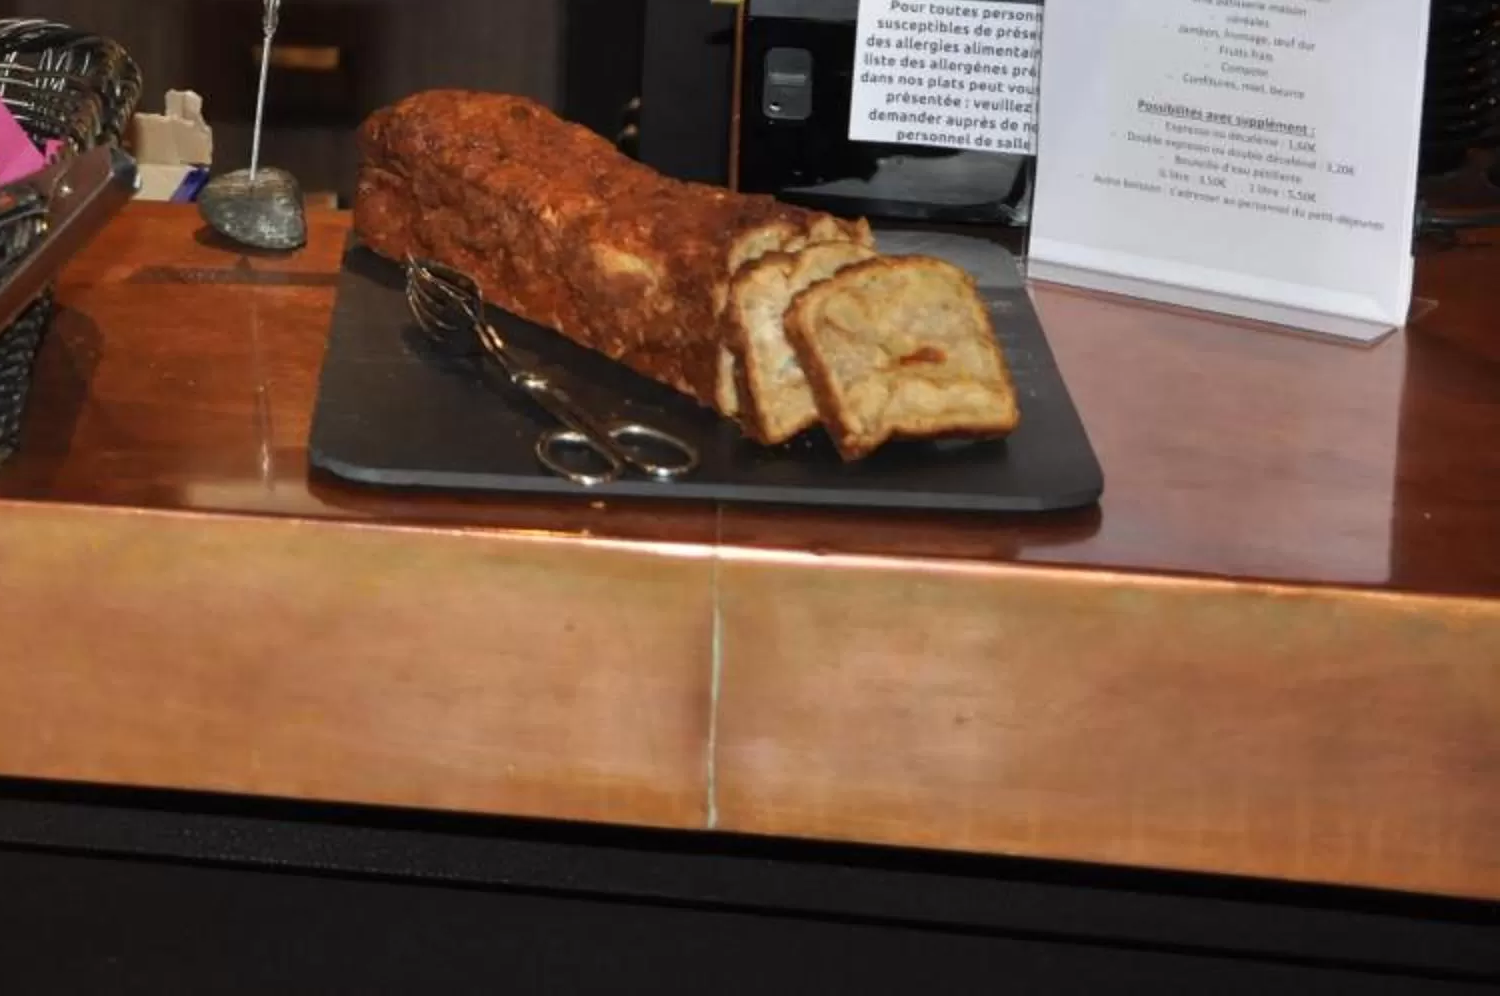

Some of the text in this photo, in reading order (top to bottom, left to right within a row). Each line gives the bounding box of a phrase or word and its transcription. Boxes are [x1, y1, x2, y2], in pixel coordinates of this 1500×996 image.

[891, 0, 926, 13] Pour
[929, 3, 978, 17] toutes
[877, 18, 969, 36] susceptibles
[973, 24, 993, 37] de
[866, 34, 891, 49] des
[895, 36, 959, 55] allergies
[863, 52, 896, 67] liste
[900, 55, 926, 69] des
[930, 57, 1007, 75] allergènes
[860, 72, 894, 85] dans
[897, 74, 923, 86] nos
[927, 75, 965, 90] plats
[969, 80, 1003, 94] peut
[886, 91, 962, 108] présentée
[973, 97, 1033, 113] veuillez
[868, 107, 942, 125] demander
[945, 112, 996, 130] auprès
[1000, 117, 1018, 131] de
[896, 128, 1031, 151] personnel de salle
